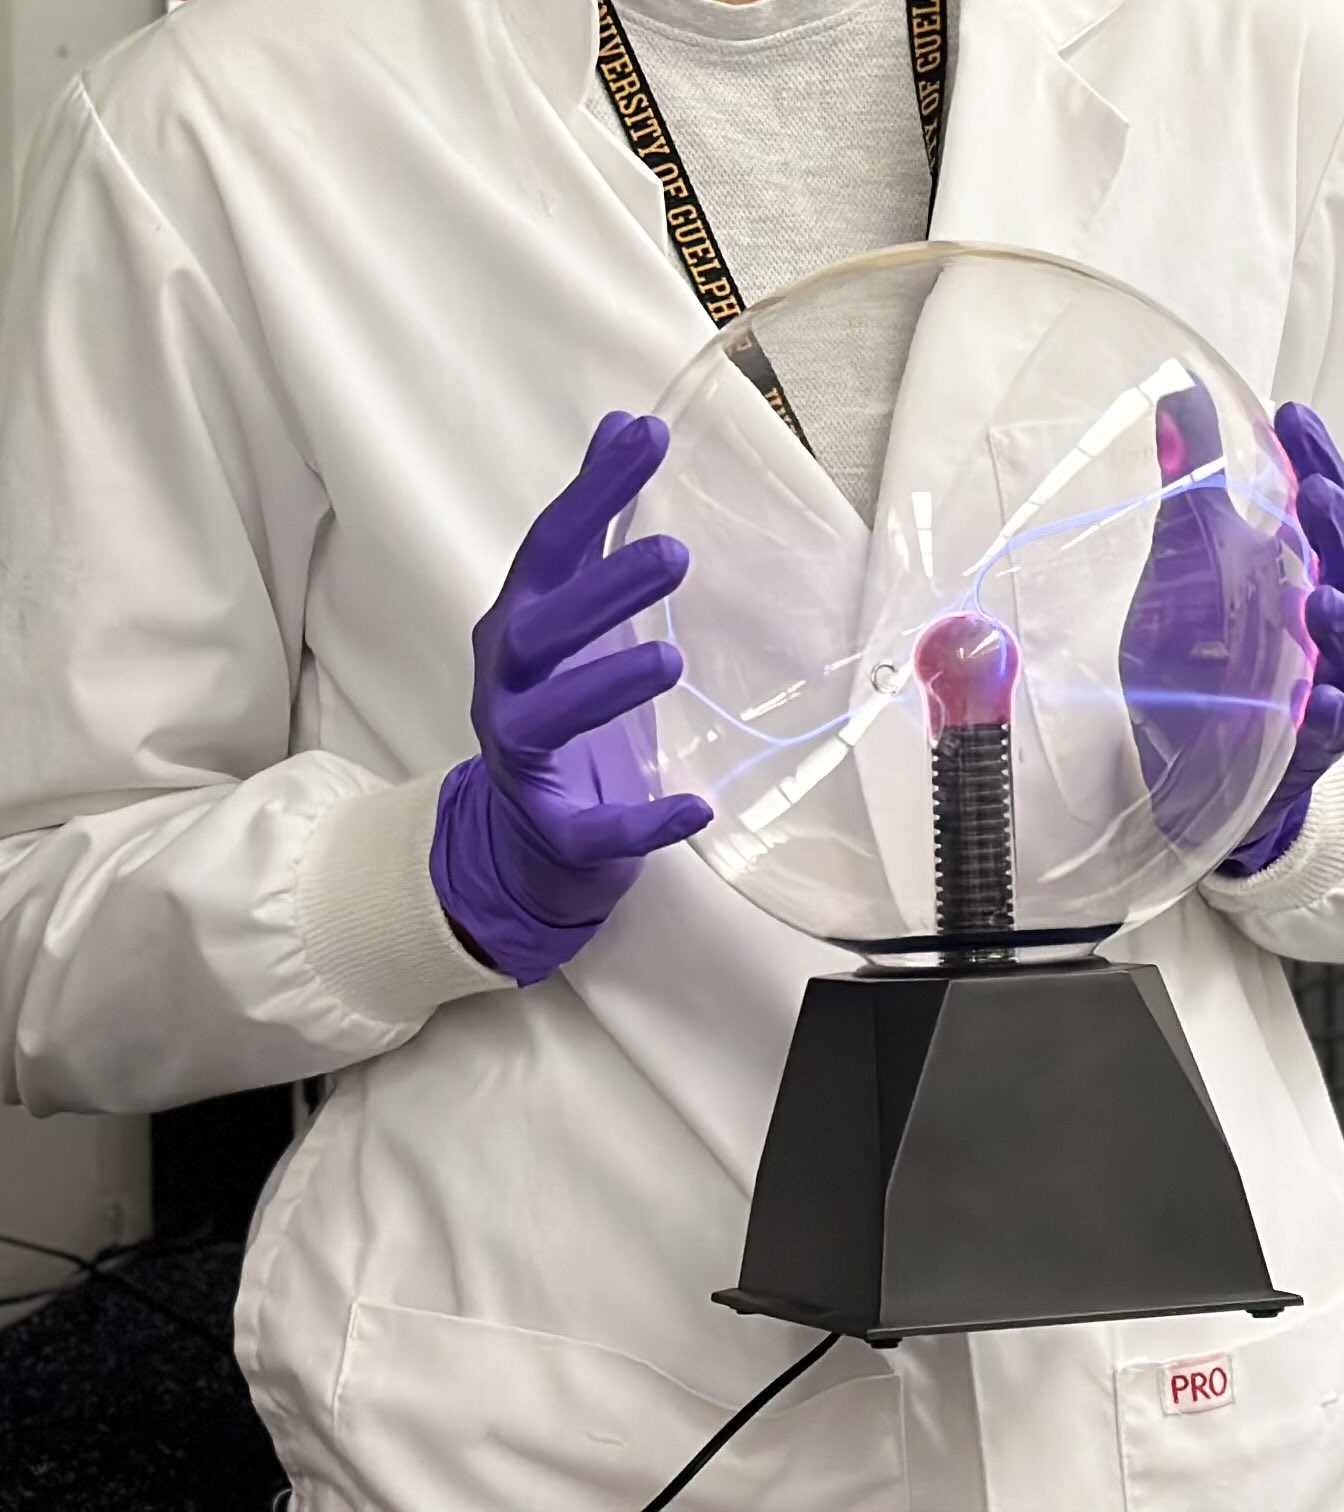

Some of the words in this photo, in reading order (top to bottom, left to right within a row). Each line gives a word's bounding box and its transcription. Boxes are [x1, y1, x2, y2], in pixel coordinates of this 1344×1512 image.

[919, 80, 941, 116] OF
[652, 162, 688, 198] OF
[667, 204, 741, 322] GUELPH
[1170, 1366, 1228, 1405] PRO
